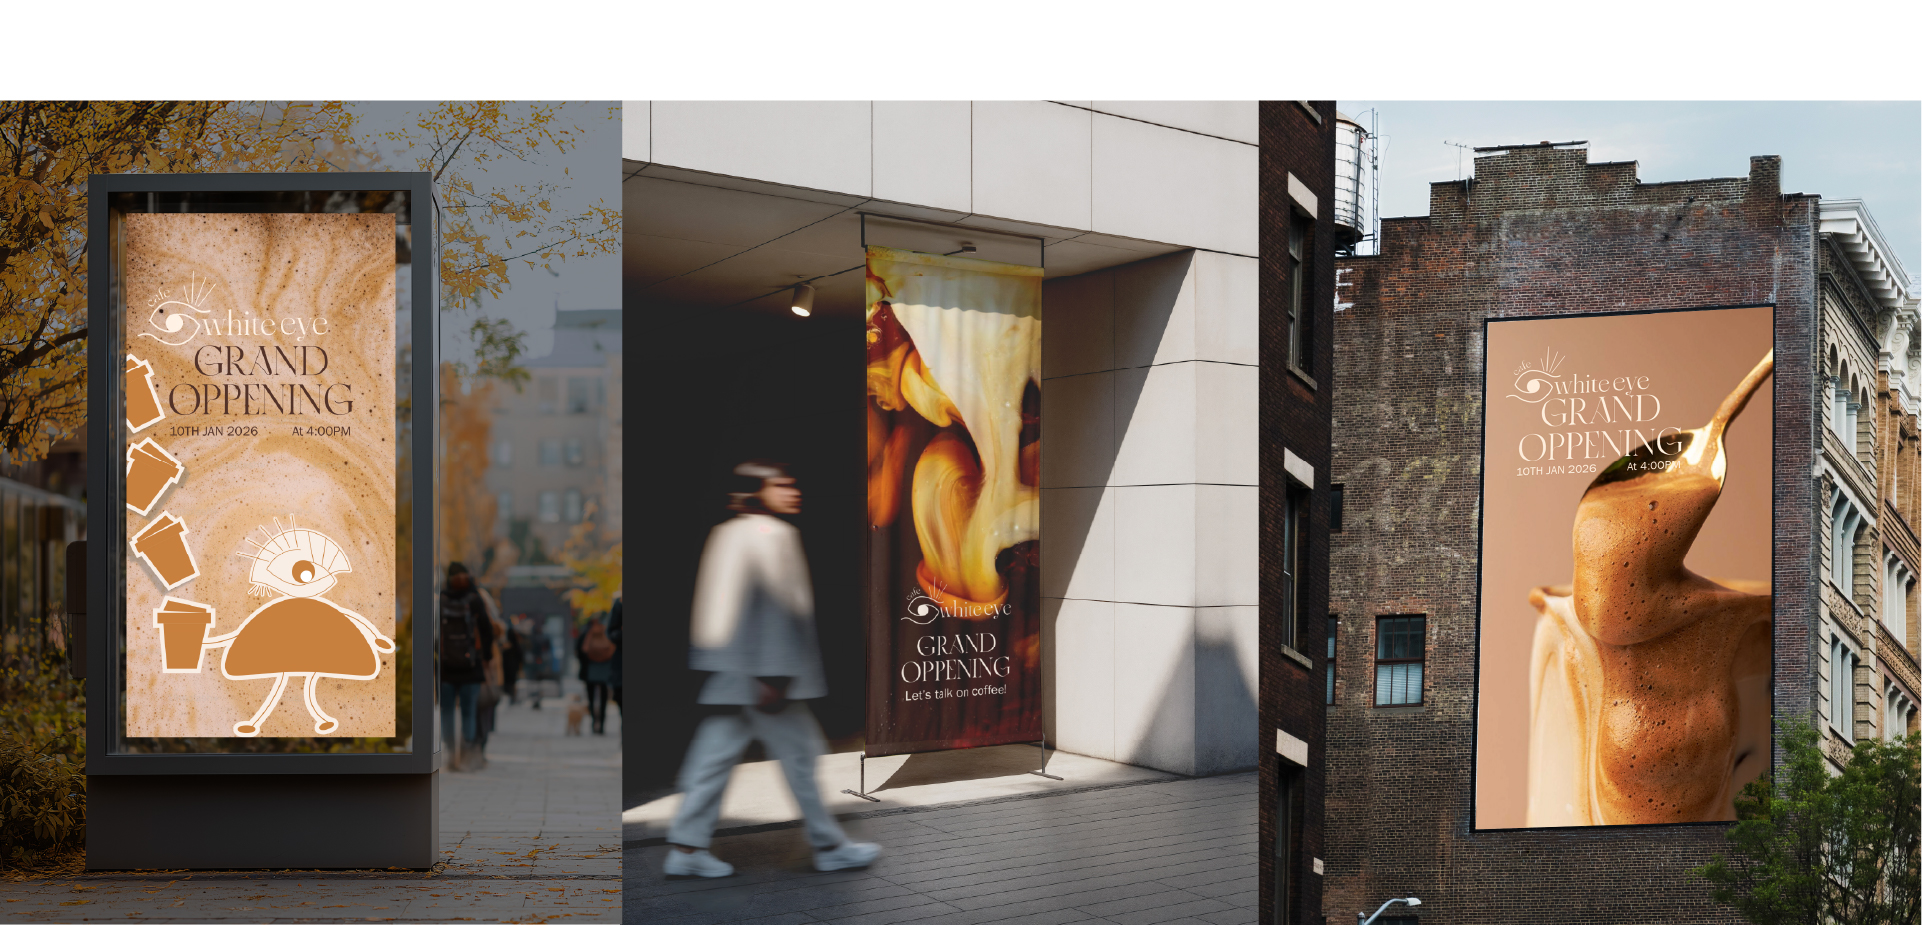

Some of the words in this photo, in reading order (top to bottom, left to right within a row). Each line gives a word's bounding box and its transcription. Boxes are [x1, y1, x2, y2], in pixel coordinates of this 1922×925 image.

[147, 287, 171, 307] cafe
[202, 309, 276, 336] white
[280, 316, 328, 341] eye
[194, 345, 328, 376] GRAND
[1513, 360, 1532, 376] cafe
[1554, 373, 1610, 395] white
[1613, 375, 1650, 396] eye
[168, 383, 353, 415] OPPENING
[1541, 394, 1661, 427] GRAND
[170, 426, 199, 436] 10TH
[202, 426, 224, 436] JAN
[227, 426, 258, 436] 2026
[292, 426, 304, 436] At
[306, 426, 351, 436] 4:00PM
[1518, 426, 1682, 462] OPPENING
[1516, 466, 1543, 476] 10TH
[1546, 466, 1565, 475] JAN
[1568, 464, 1597, 474] 2026
[1626, 462, 1638, 471] At
[1640, 460, 1681, 470] 4:00PM
[940, 600, 982, 618] white
[984, 602, 1012, 619] eye
[917, 632, 997, 656] GRAND
[901, 656, 1010, 683] OPPENING
[905, 690, 932, 702] Let's
[935, 688, 953, 699] talk
[956, 688, 969, 697] on
[972, 684, 1007, 696] coffee!
